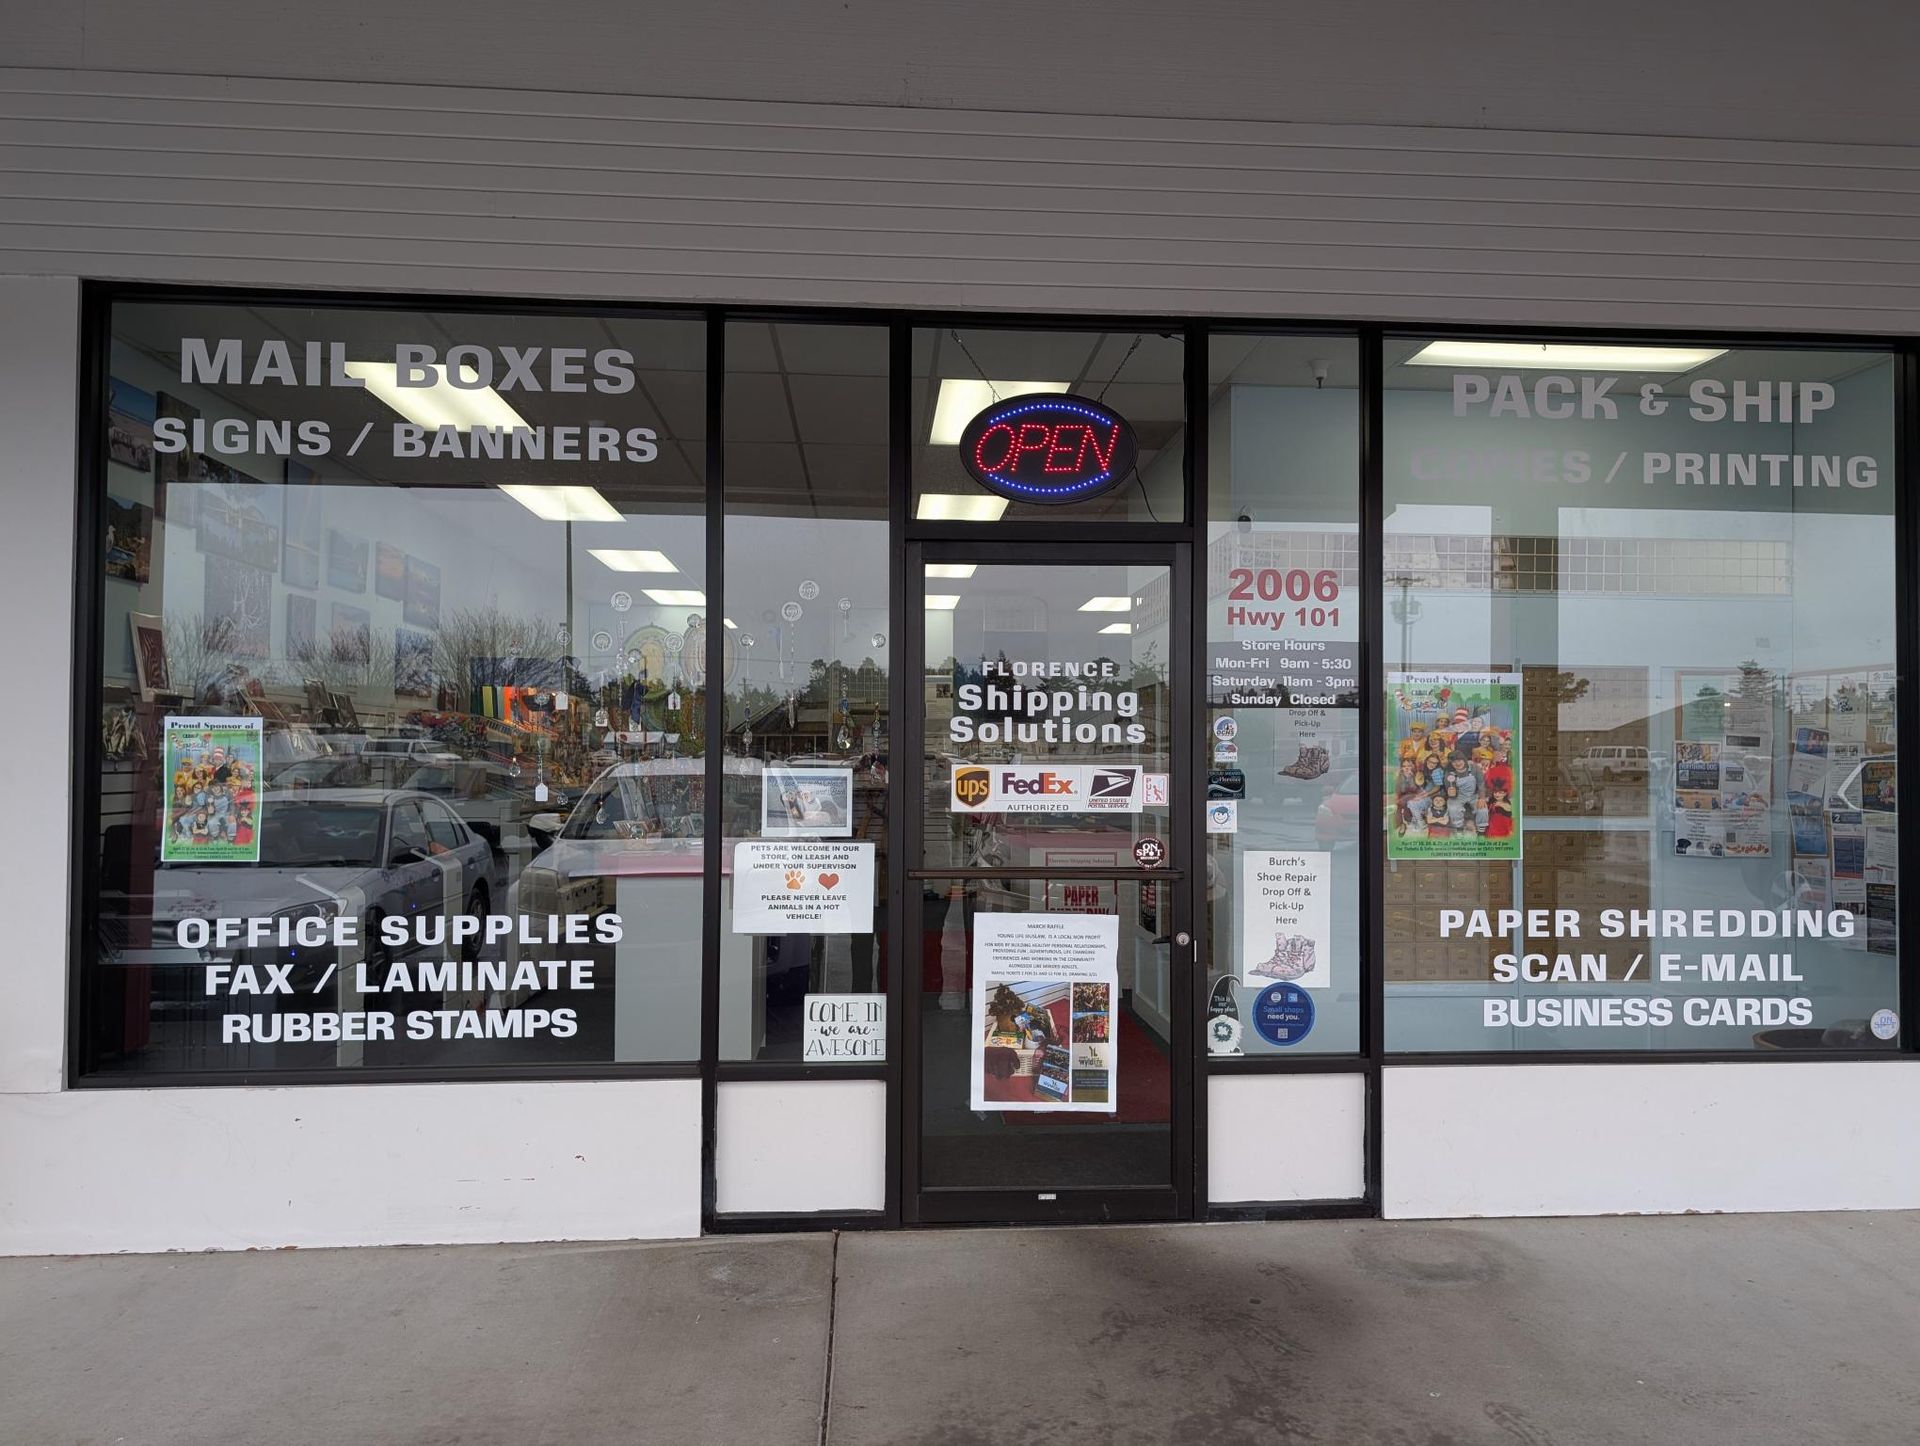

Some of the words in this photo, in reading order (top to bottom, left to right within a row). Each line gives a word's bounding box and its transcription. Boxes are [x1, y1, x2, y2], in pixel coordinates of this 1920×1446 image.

[181, 338, 366, 387] MAIL
[396, 344, 636, 393] BOXES
[1453, 374, 1618, 420] PACK
[1640, 383, 1669, 416] &
[1689, 379, 1836, 423] SHIP
[153, 416, 332, 456] SIGNS
[346, 422, 375, 456] /
[393, 424, 659, 463] BANNERS
[976, 424, 1120, 472] OPEN
[1411, 447, 1591, 484] COPIES
[1604, 452, 1629, 484] /
[1643, 452, 1878, 489] PRINTING
[1228, 568, 1339, 602] 2006
[1227, 607, 1285, 631] Hwy
[1295, 607, 1338, 627] 101
[1242, 640, 1280, 651] Store
[1285, 640, 1325, 651] Hours
[982, 661, 1114, 677] FLORENCE
[1215, 658, 1269, 668] Mon-Fri
[1280, 658, 1309, 669] 9am
[1321, 659, 1351, 669] 5:30
[1212, 675, 1275, 688] Saturday
[1283, 676, 1312, 686] 11am
[1325, 676, 1354, 688] 3pm
[1406, 675, 1439, 683] Proud
[1443, 676, 1486, 684] Sponsor
[958, 684, 1138, 717] Shipping
[1231, 694, 1281, 706] Sunday
[1290, 694, 1336, 705] Closed
[204, 722, 242, 730] Sponsor
[950, 716, 1146, 743] Solutions
[957, 779, 988, 802] ups
[1002, 773, 1073, 795] FedEx
[1142, 843, 1158, 851] ON
[1269, 857, 1306, 866] Burch's
[1257, 872, 1282, 881] Shoe
[1285, 873, 1317, 883] Repair
[1064, 886, 1098, 906] PAPER
[1262, 888, 1285, 897] Drop
[1304, 888, 1312, 896] &
[1269, 902, 1304, 911] Pick-Up
[1276, 916, 1298, 924] Here
[1440, 909, 1580, 938] PAPER
[1600, 908, 1855, 939] SHREDDING
[177, 916, 359, 949] OFFICE
[380, 913, 624, 946] SUPPLIES
[205, 963, 295, 995] FAX
[313, 963, 337, 994] /
[355, 960, 595, 993] LAMINATE
[1493, 954, 1607, 983] SCAN
[1623, 954, 1644, 983] /
[1659, 953, 1804, 983] E-MAIL
[810, 1001, 858, 1022] COME
[864, 1002, 882, 1022] IN
[1483, 997, 1673, 1027] BUSINESS
[1683, 997, 1812, 1027] CARDS
[222, 1012, 394, 1044] RUBBER
[406, 1008, 577, 1040] STAMPS
[820, 1025, 840, 1036] we
[848, 1025, 871, 1035] are
[806, 1038, 884, 1056] AWESOME
